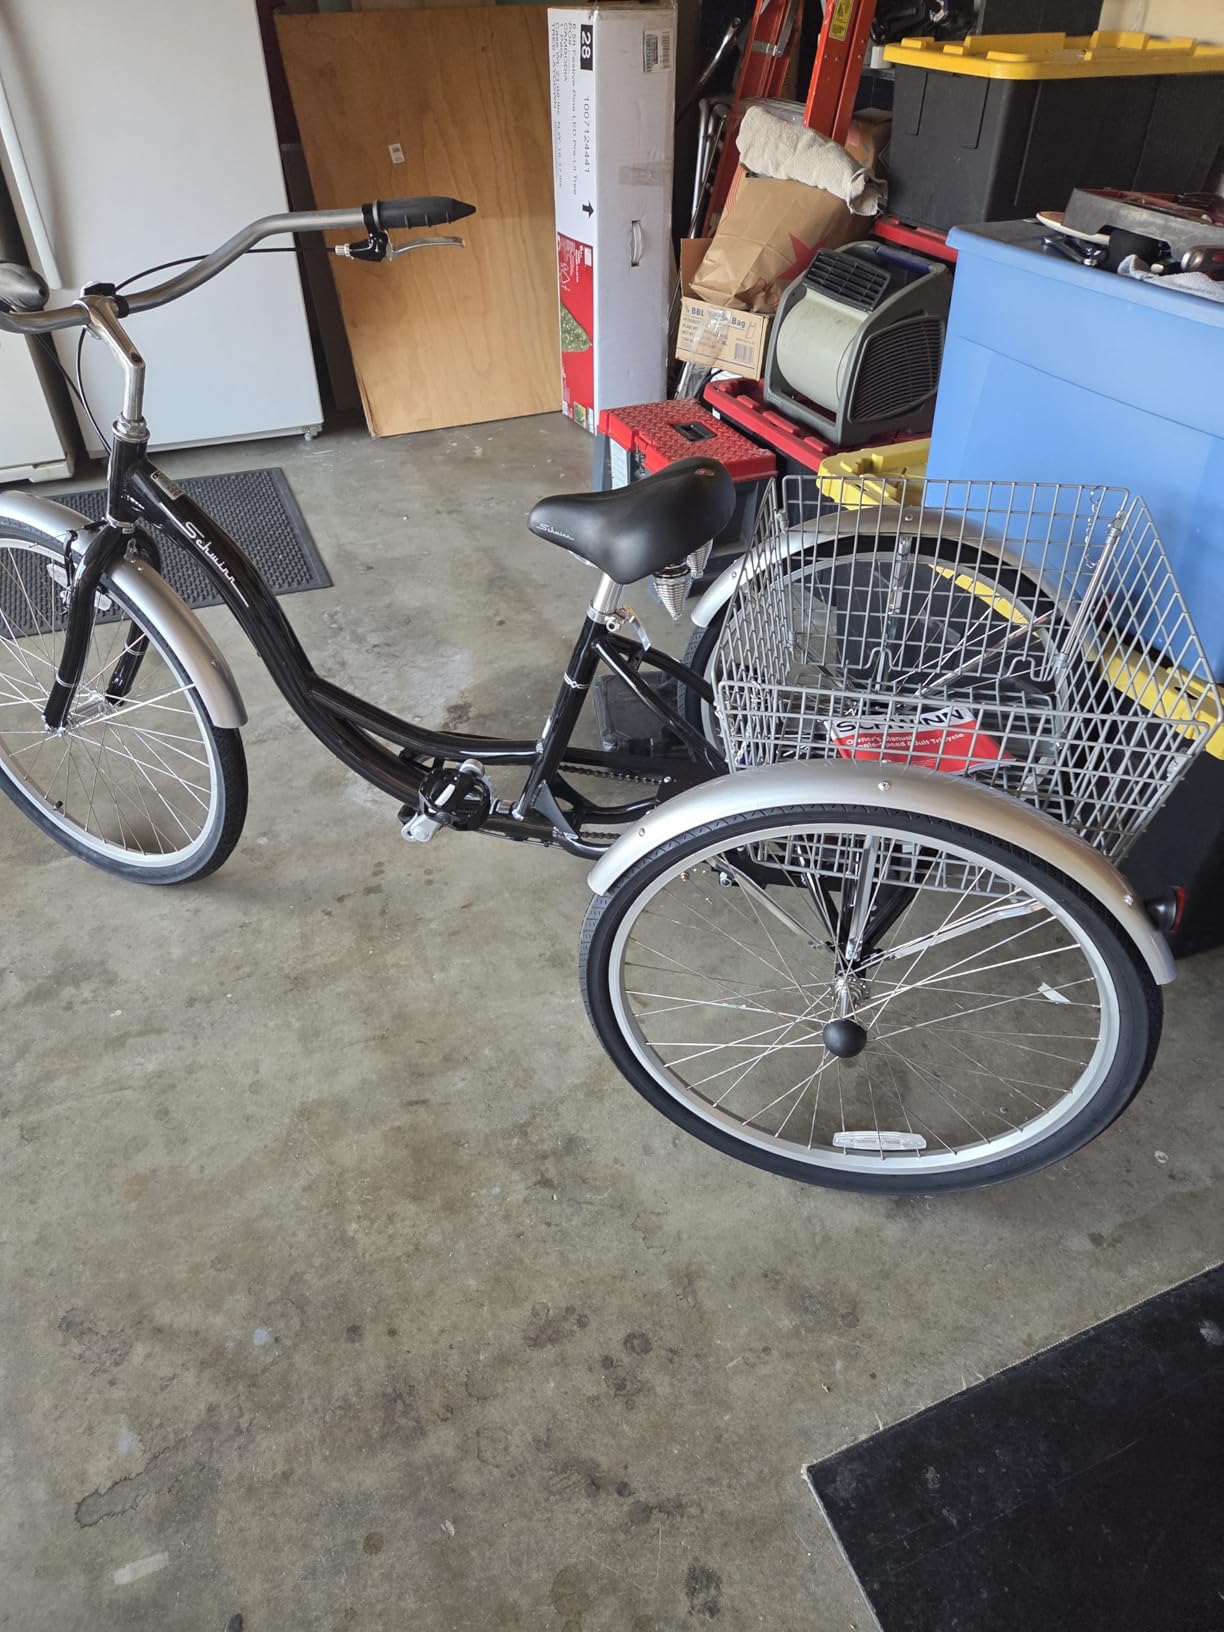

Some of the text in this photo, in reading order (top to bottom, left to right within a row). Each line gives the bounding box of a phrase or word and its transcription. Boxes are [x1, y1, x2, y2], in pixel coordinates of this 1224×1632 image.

[582, 31, 591, 58] 28
[732, 317, 746, 328] Bag
[159, 501, 250, 609] Schwinn
[929, 733, 965, 745] Triycle
